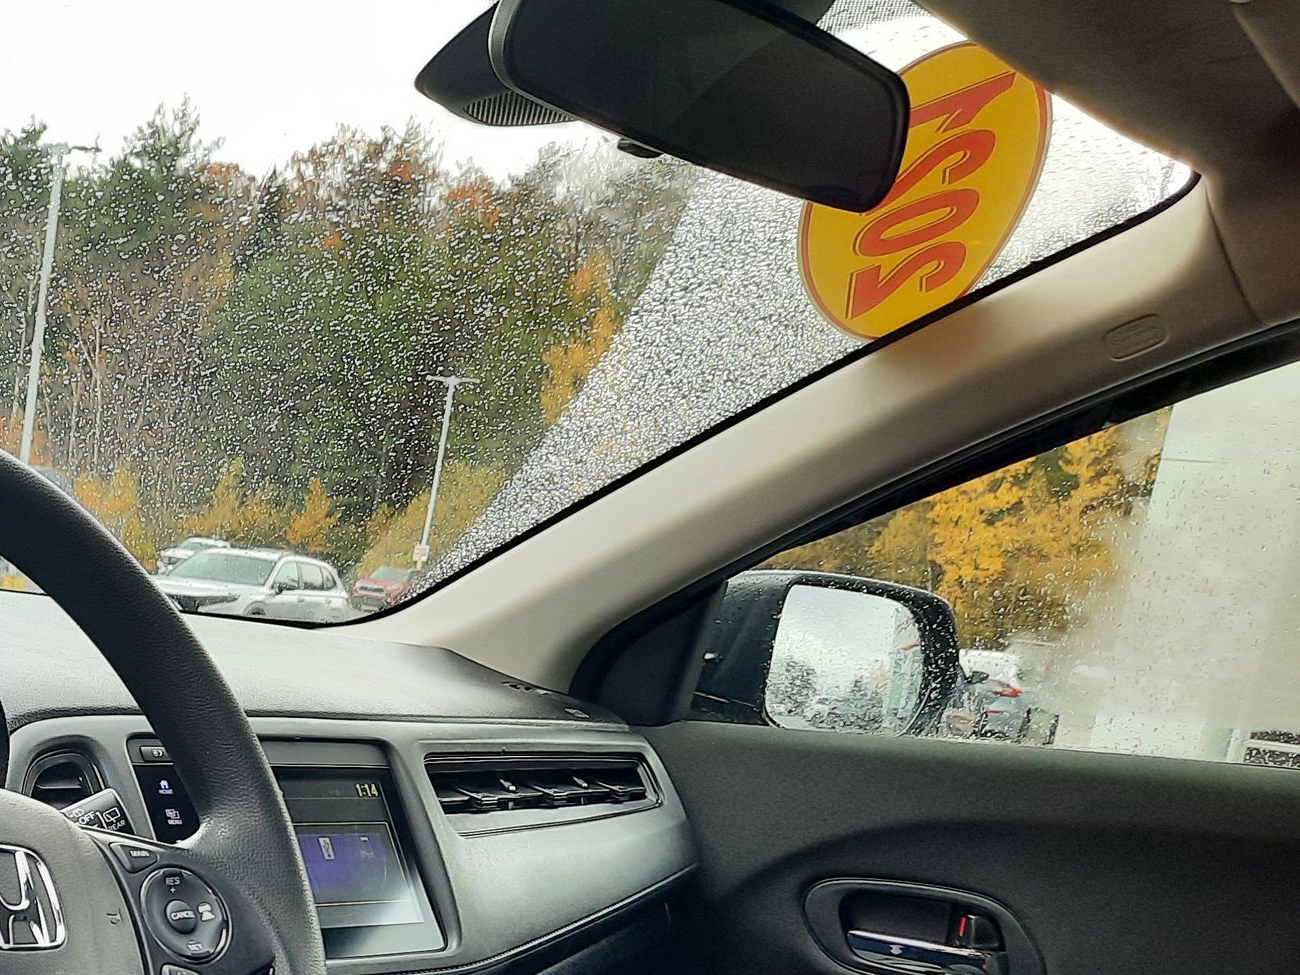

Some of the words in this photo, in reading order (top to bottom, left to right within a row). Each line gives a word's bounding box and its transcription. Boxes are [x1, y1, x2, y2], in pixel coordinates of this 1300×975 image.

[355, 783, 380, 798] 1:14
[78, 810, 96, 825] OFF
[165, 876, 181, 886] RES
